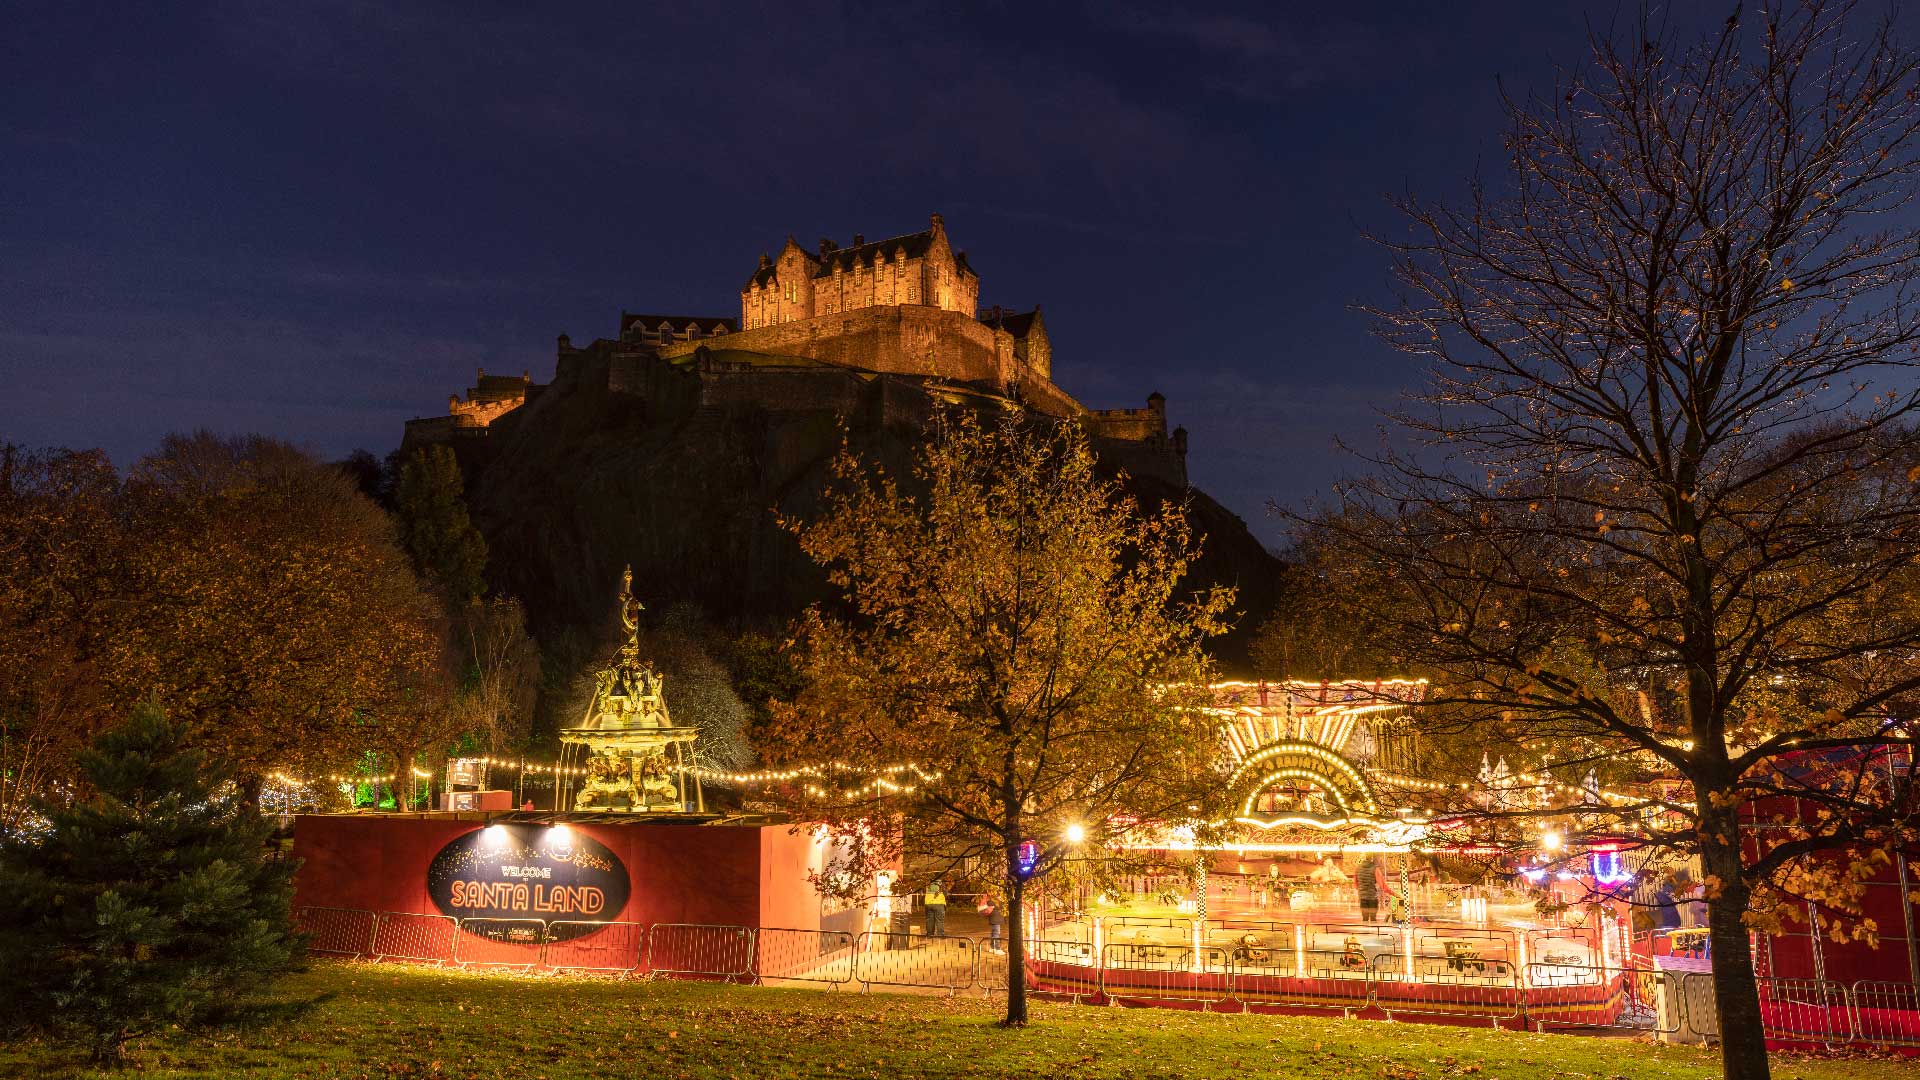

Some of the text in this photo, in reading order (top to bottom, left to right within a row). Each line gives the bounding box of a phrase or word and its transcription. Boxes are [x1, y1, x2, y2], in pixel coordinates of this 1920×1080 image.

[501, 865, 551, 879] WELCOME
[451, 880, 604, 914] SANTA LAND
